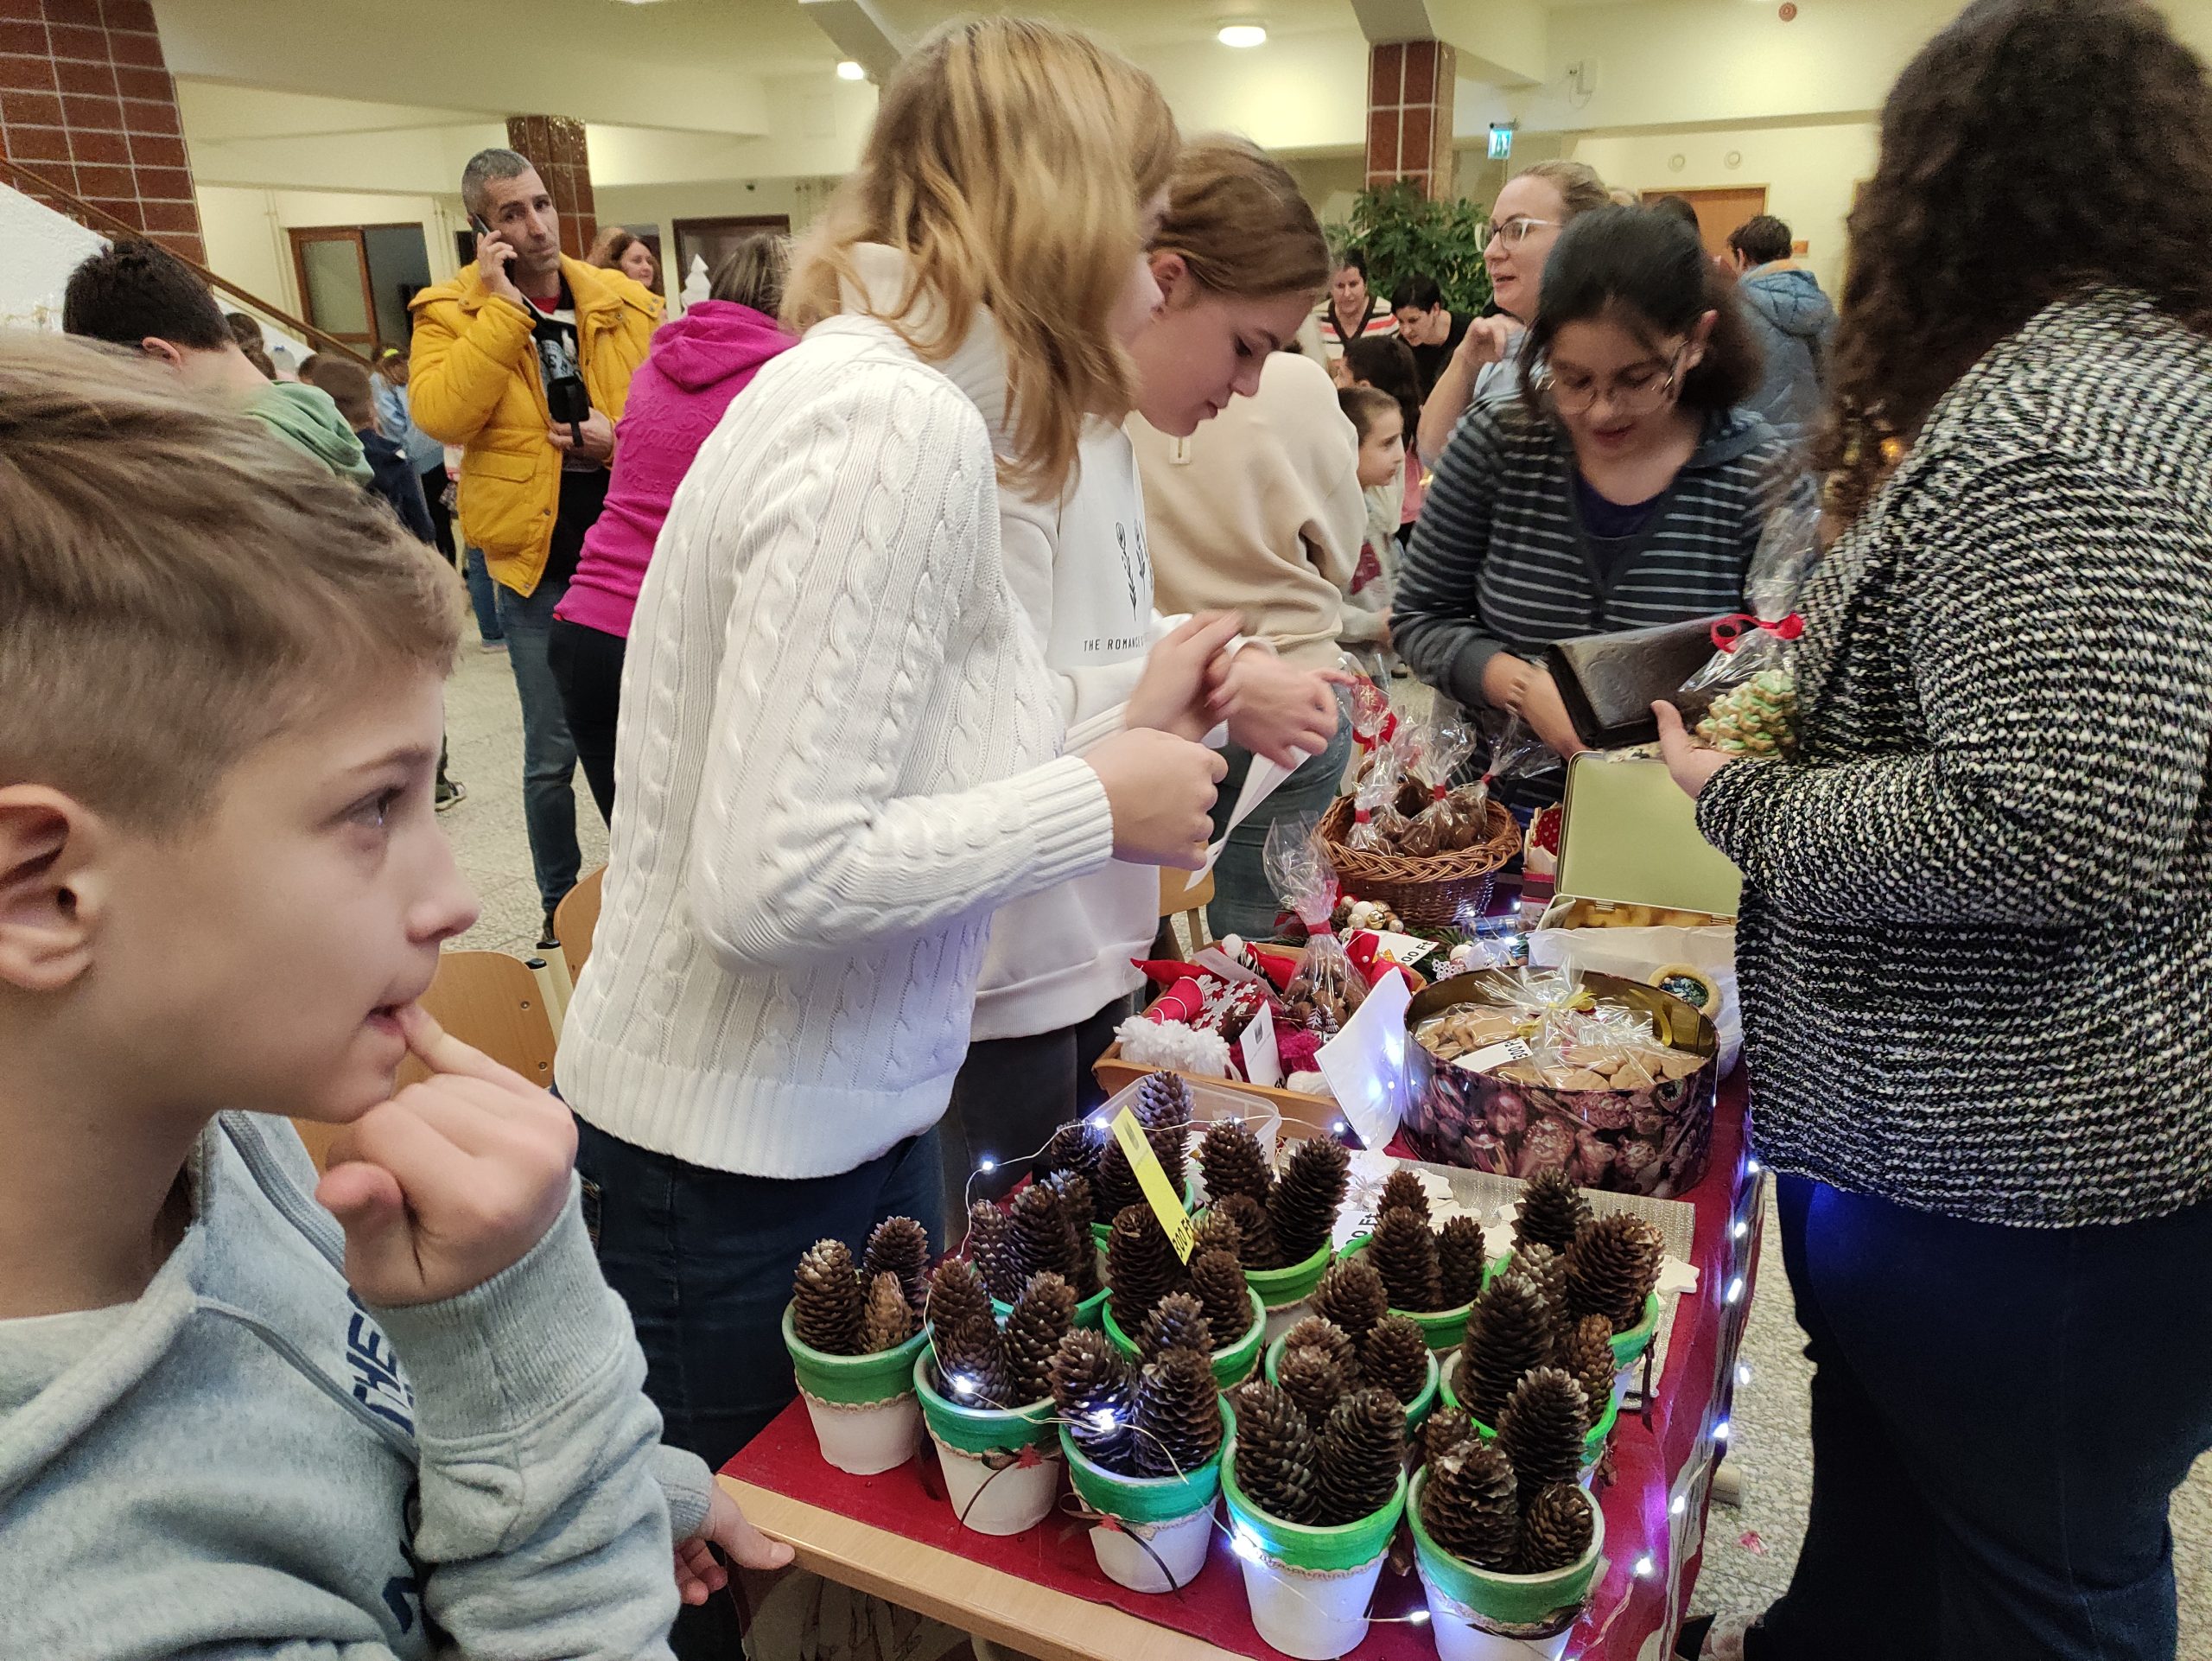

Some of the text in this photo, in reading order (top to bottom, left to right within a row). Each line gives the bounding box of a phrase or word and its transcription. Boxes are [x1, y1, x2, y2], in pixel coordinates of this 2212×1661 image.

[1084, 639, 1101, 652] THE
[1401, 941, 1433, 965] 00 Ft
[1504, 1039, 1529, 1060] 300 F
[1172, 1217, 1194, 1258] 300 Ft
